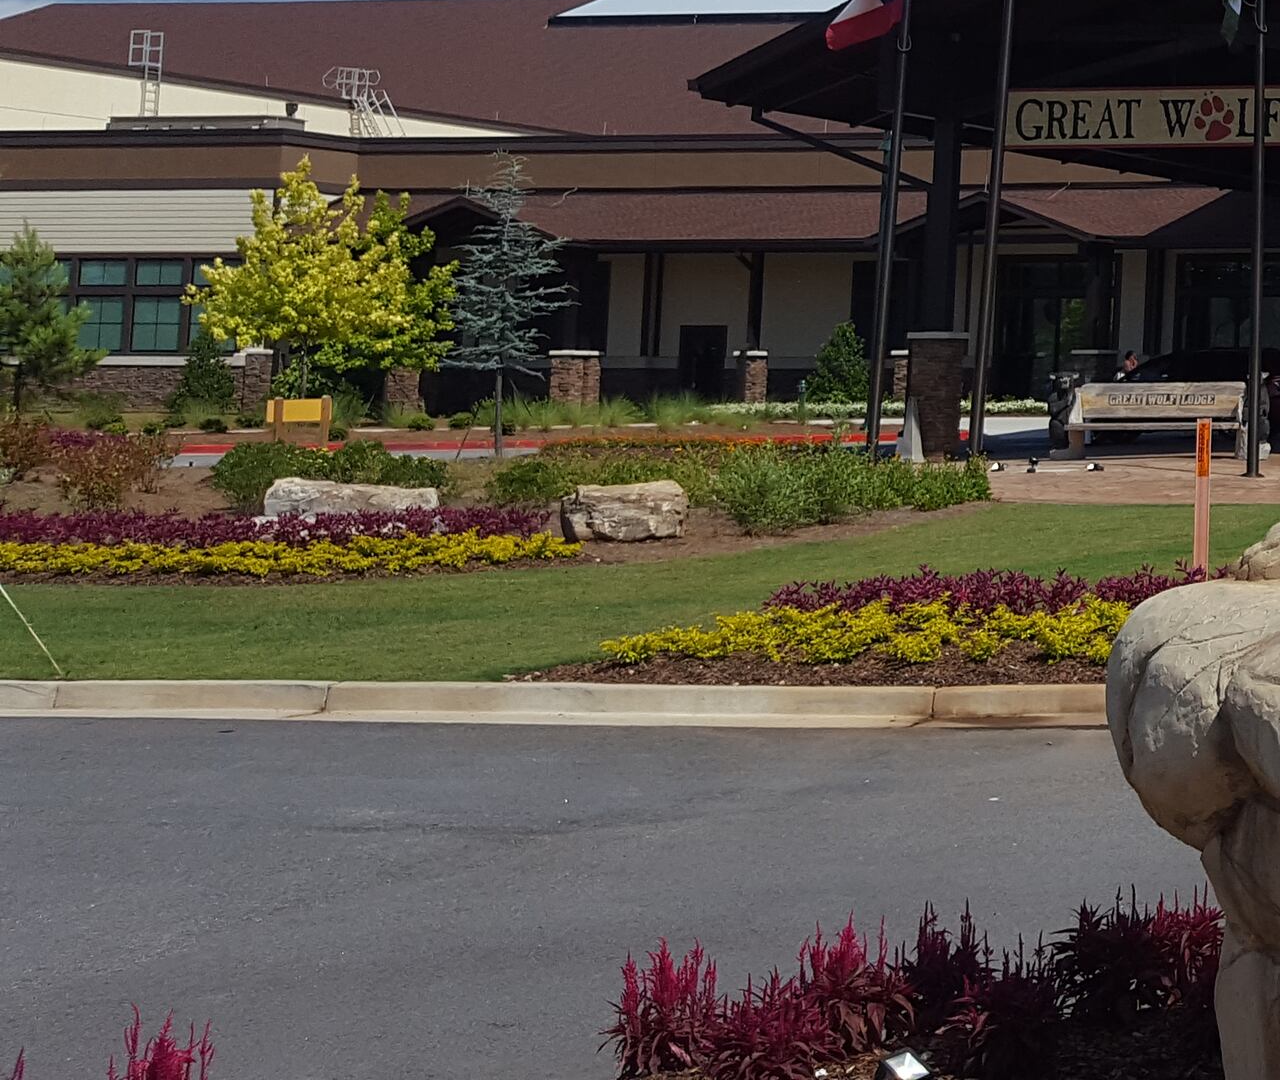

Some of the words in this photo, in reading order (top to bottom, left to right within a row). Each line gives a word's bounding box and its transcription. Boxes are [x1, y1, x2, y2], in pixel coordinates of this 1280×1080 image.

[1014, 97, 1142, 141] GREAT
[1109, 394, 1143, 405] GREAT
[1147, 394, 1177, 405] WOLF
[1180, 394, 1215, 405] LODGE
